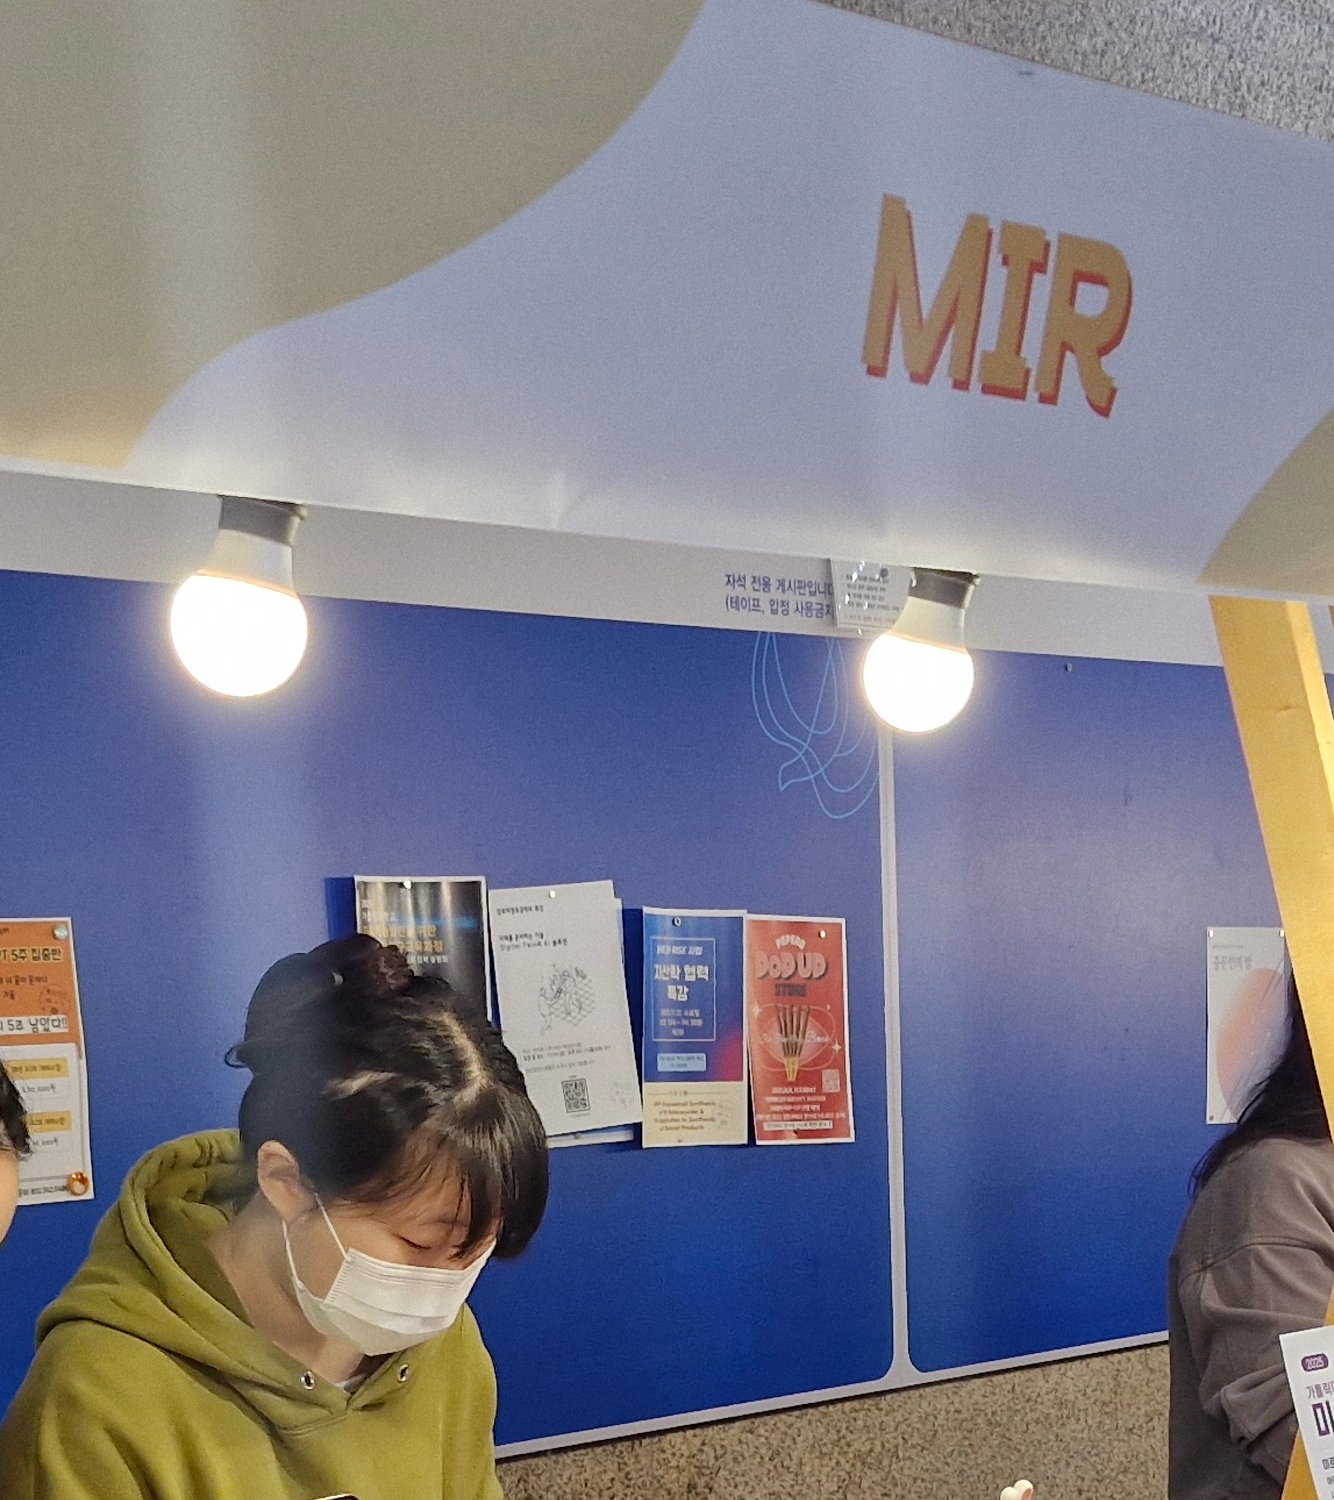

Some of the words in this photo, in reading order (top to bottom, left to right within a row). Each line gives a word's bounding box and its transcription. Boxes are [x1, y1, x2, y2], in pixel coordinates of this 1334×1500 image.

[862, 193, 1133, 418] MIR
[725, 574, 747, 589] 자석
[751, 576, 772, 593] 전용
[769, 599, 789, 617] 압정
[11, 949, 28, 963] 5주
[31, 947, 63, 962] 집중반
[797, 951, 828, 980] UP
